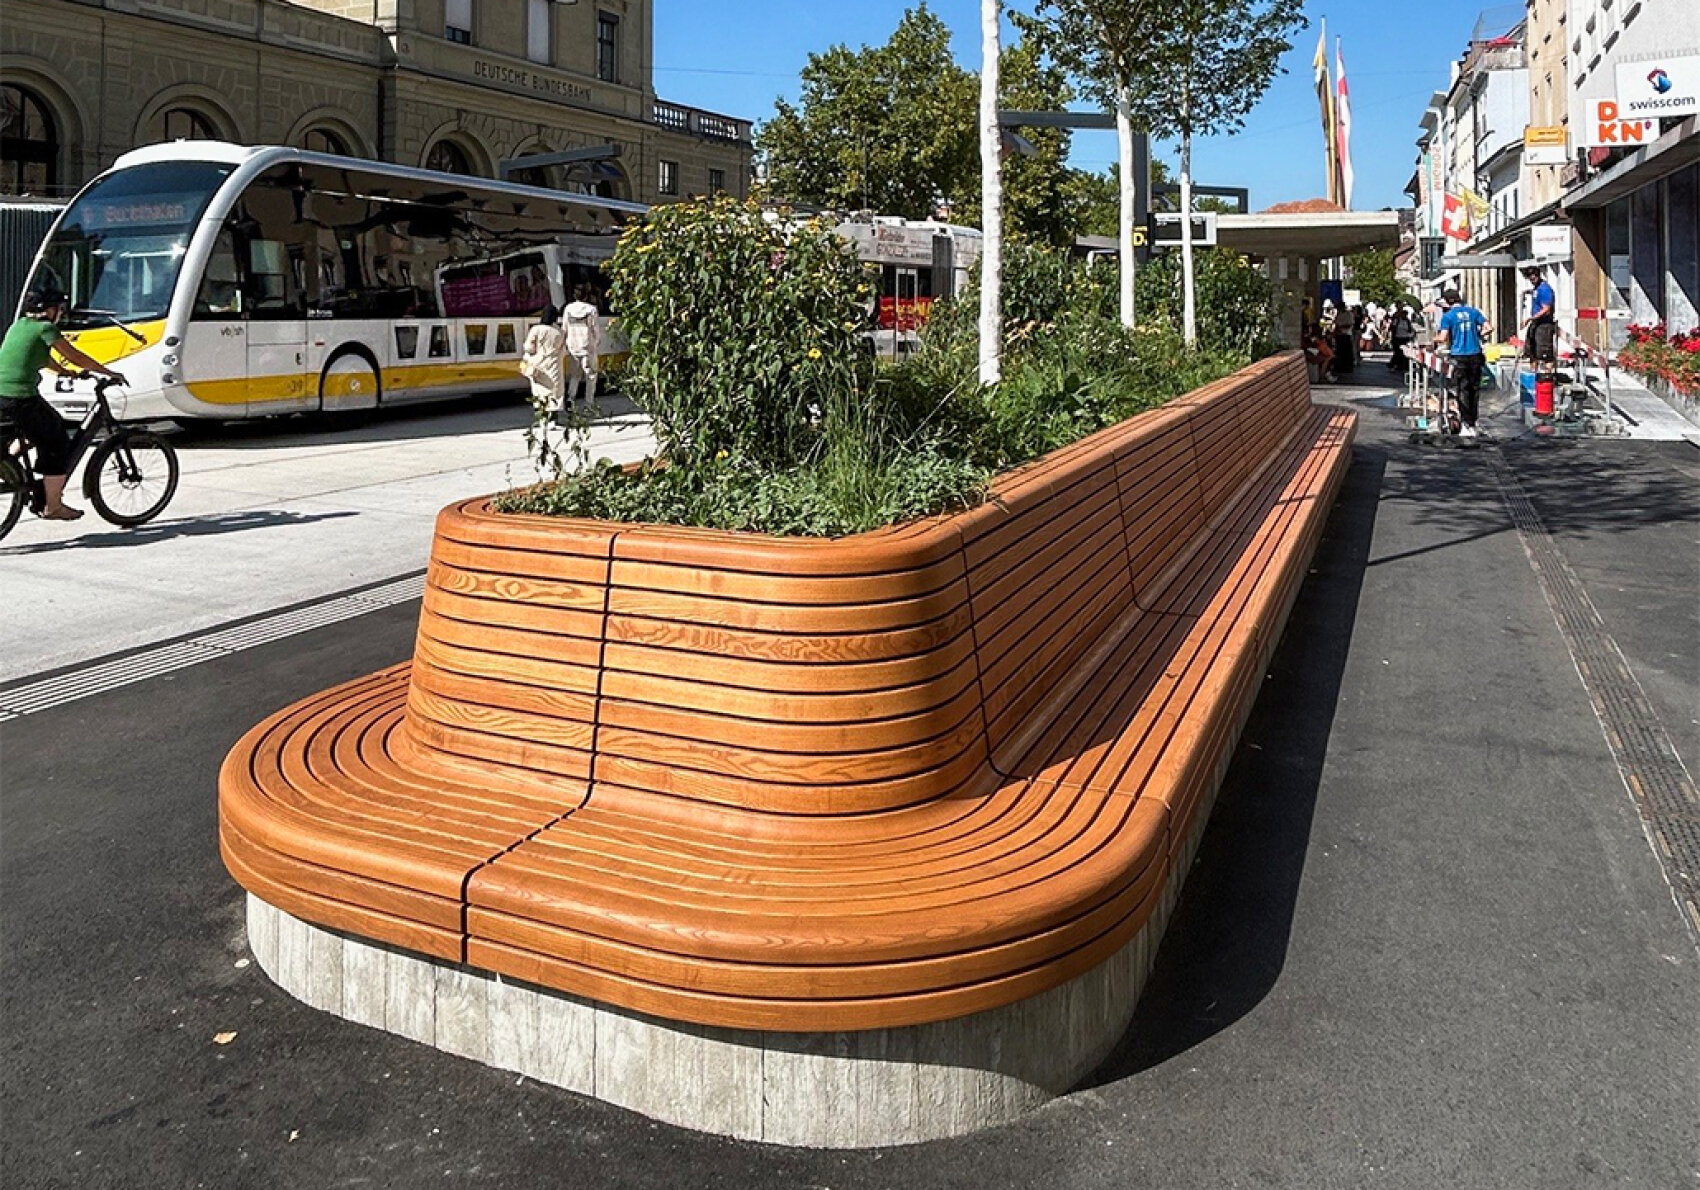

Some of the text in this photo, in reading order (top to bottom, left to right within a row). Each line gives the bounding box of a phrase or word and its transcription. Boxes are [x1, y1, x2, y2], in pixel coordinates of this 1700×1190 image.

[474, 60, 592, 101] DEUTSCHE BUNDESBAHN
[1597, 101, 1618, 122] D
[1629, 96, 1696, 110] swisscom
